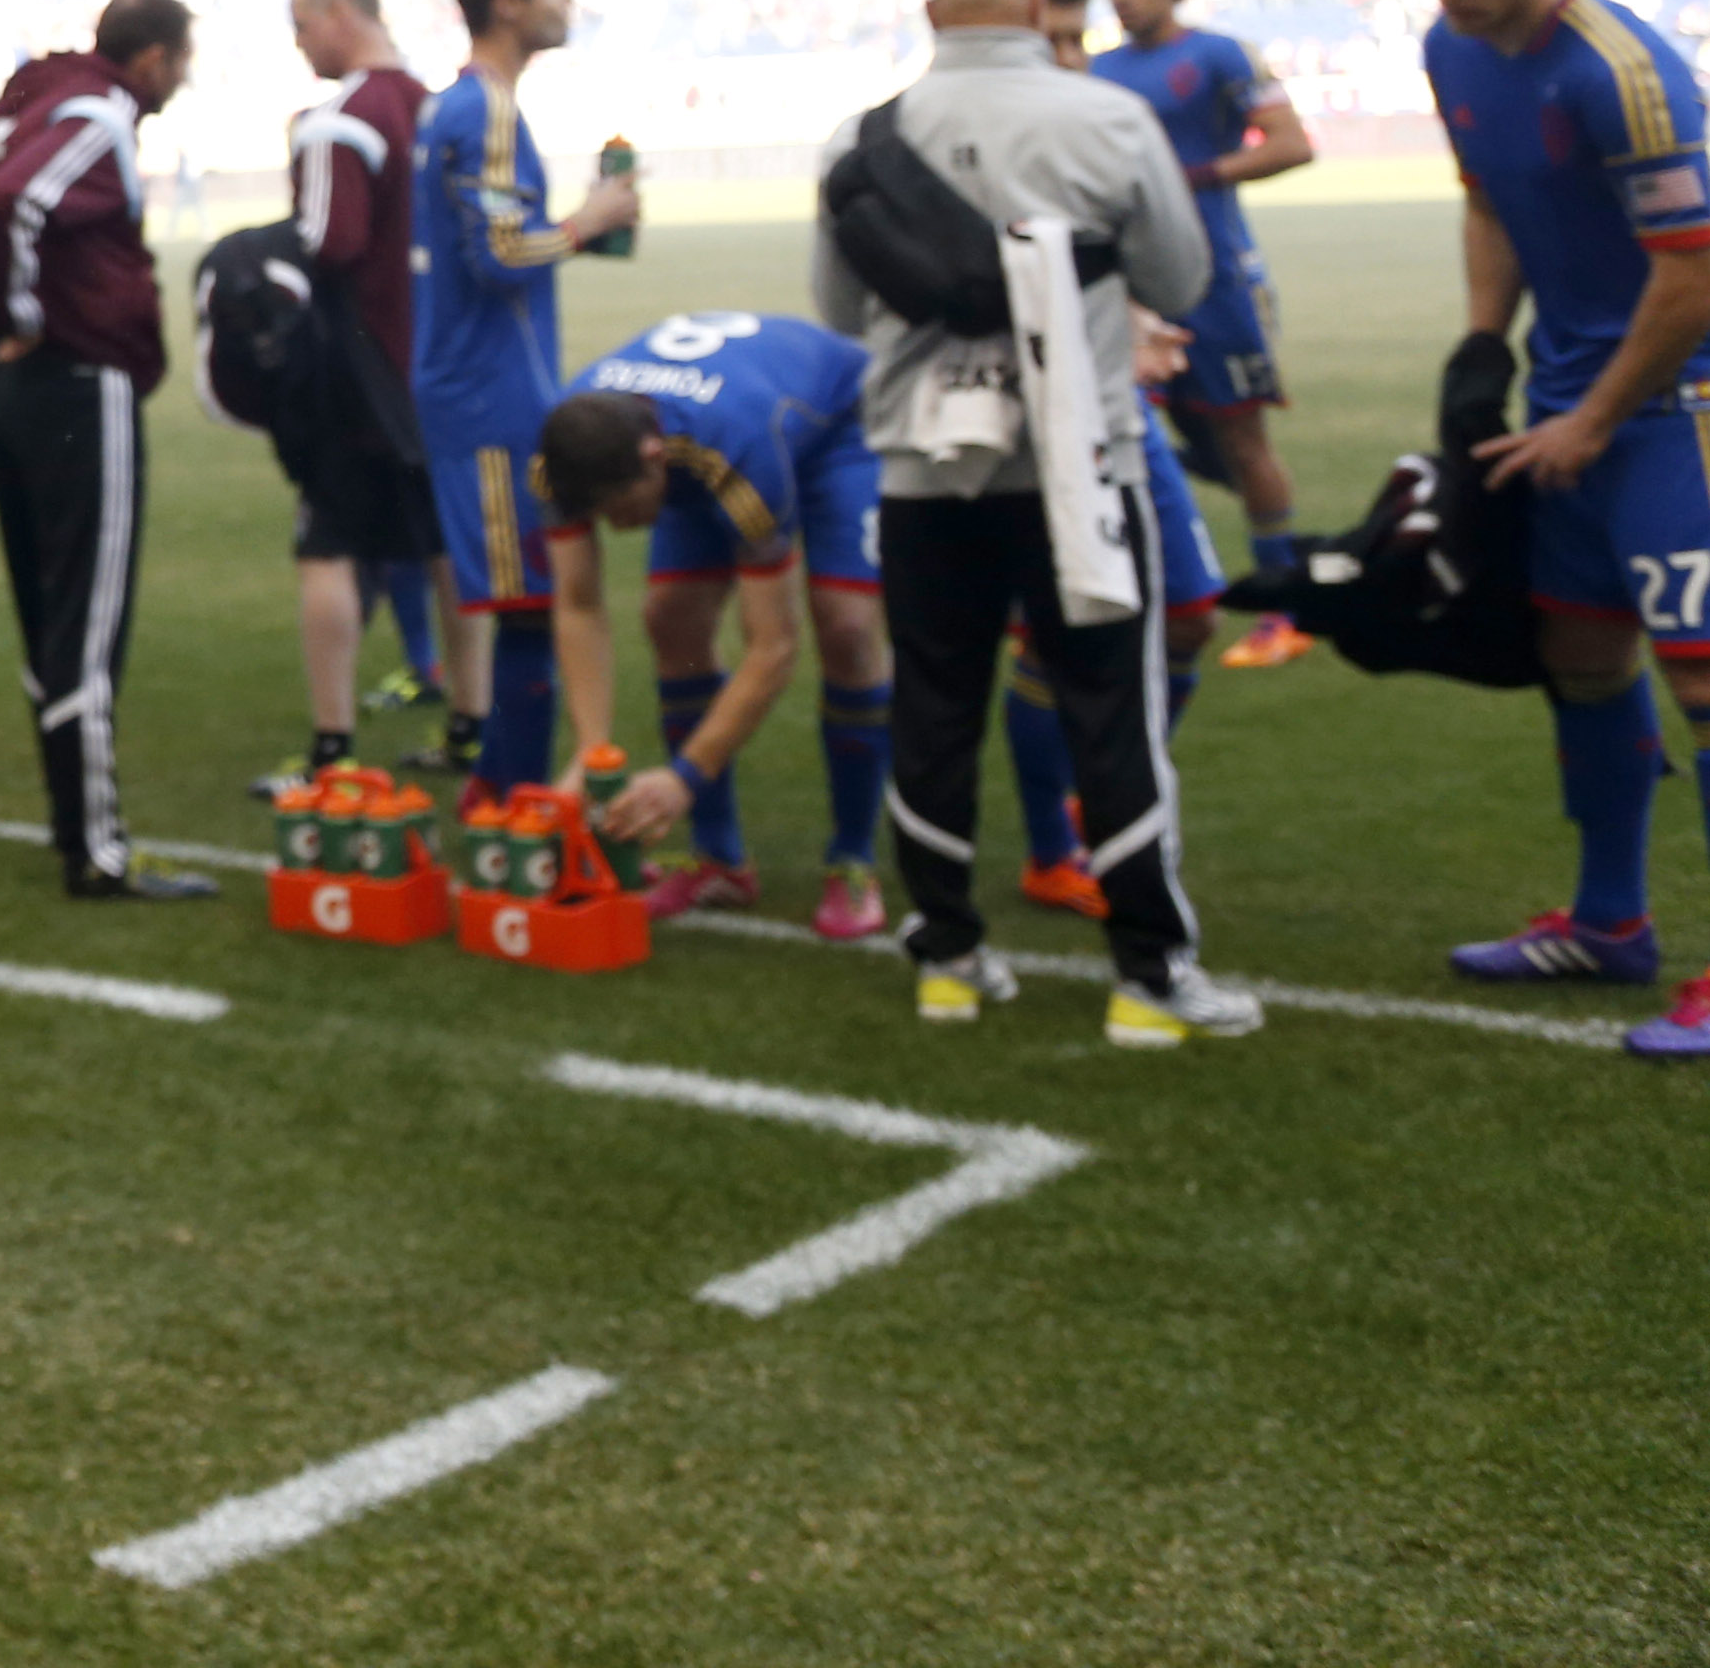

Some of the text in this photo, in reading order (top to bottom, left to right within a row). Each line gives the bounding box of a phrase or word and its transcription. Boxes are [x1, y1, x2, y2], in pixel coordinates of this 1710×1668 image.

[1629, 549, 1710, 630] 27
[311, 885, 353, 933] G
[492, 907, 531, 957] G
